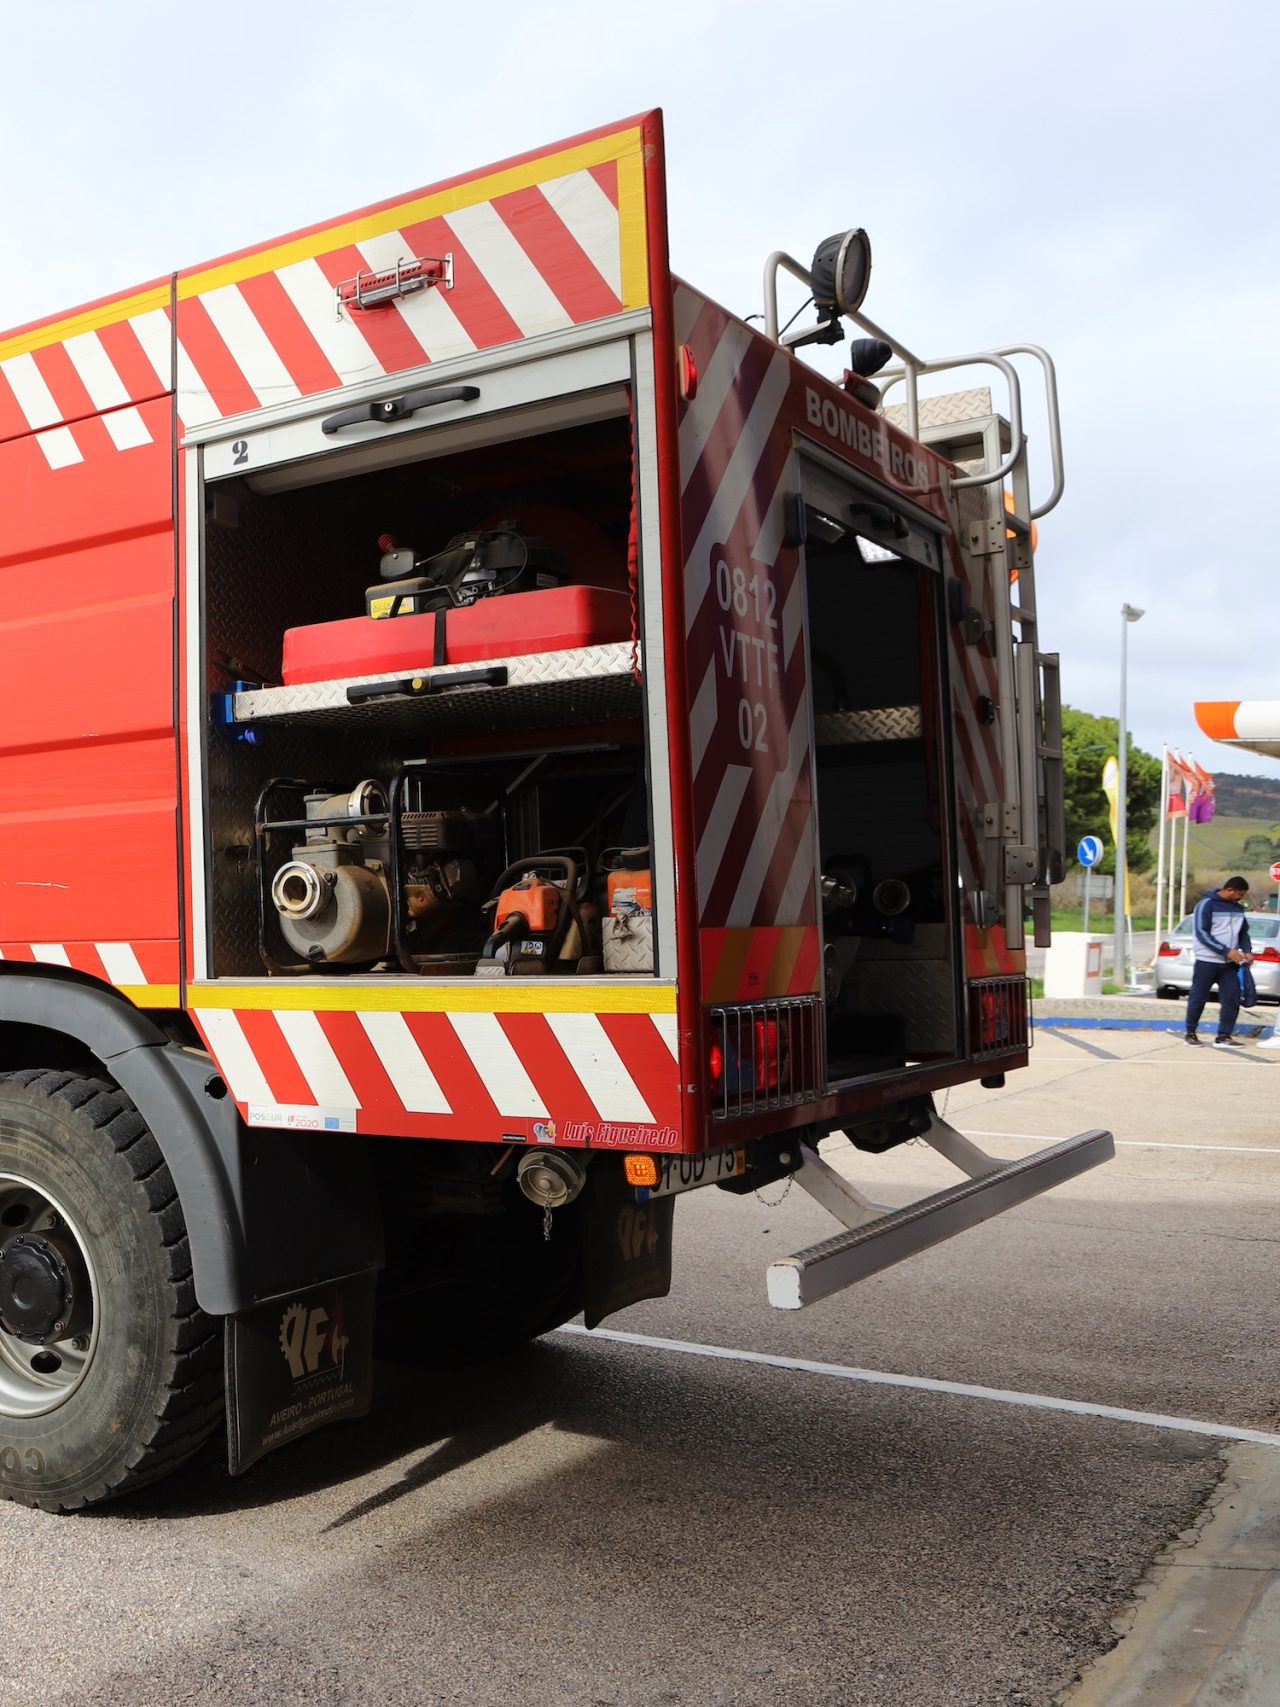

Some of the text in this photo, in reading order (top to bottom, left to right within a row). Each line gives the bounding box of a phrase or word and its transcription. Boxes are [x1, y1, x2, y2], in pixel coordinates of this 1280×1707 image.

[232, 440, 249, 466] 2
[805, 386, 929, 493] BOMBEIROS
[716, 560, 778, 629] 0812
[719, 624, 779, 689] VTTF
[738, 698, 769, 753] 02
[295, 1118, 319, 1129] 2020
[563, 1121, 678, 1147] Luís Figueiredo
[269, 1402, 302, 1426] AVEIRO
[309, 1382, 353, 1409] PORTUGAL
